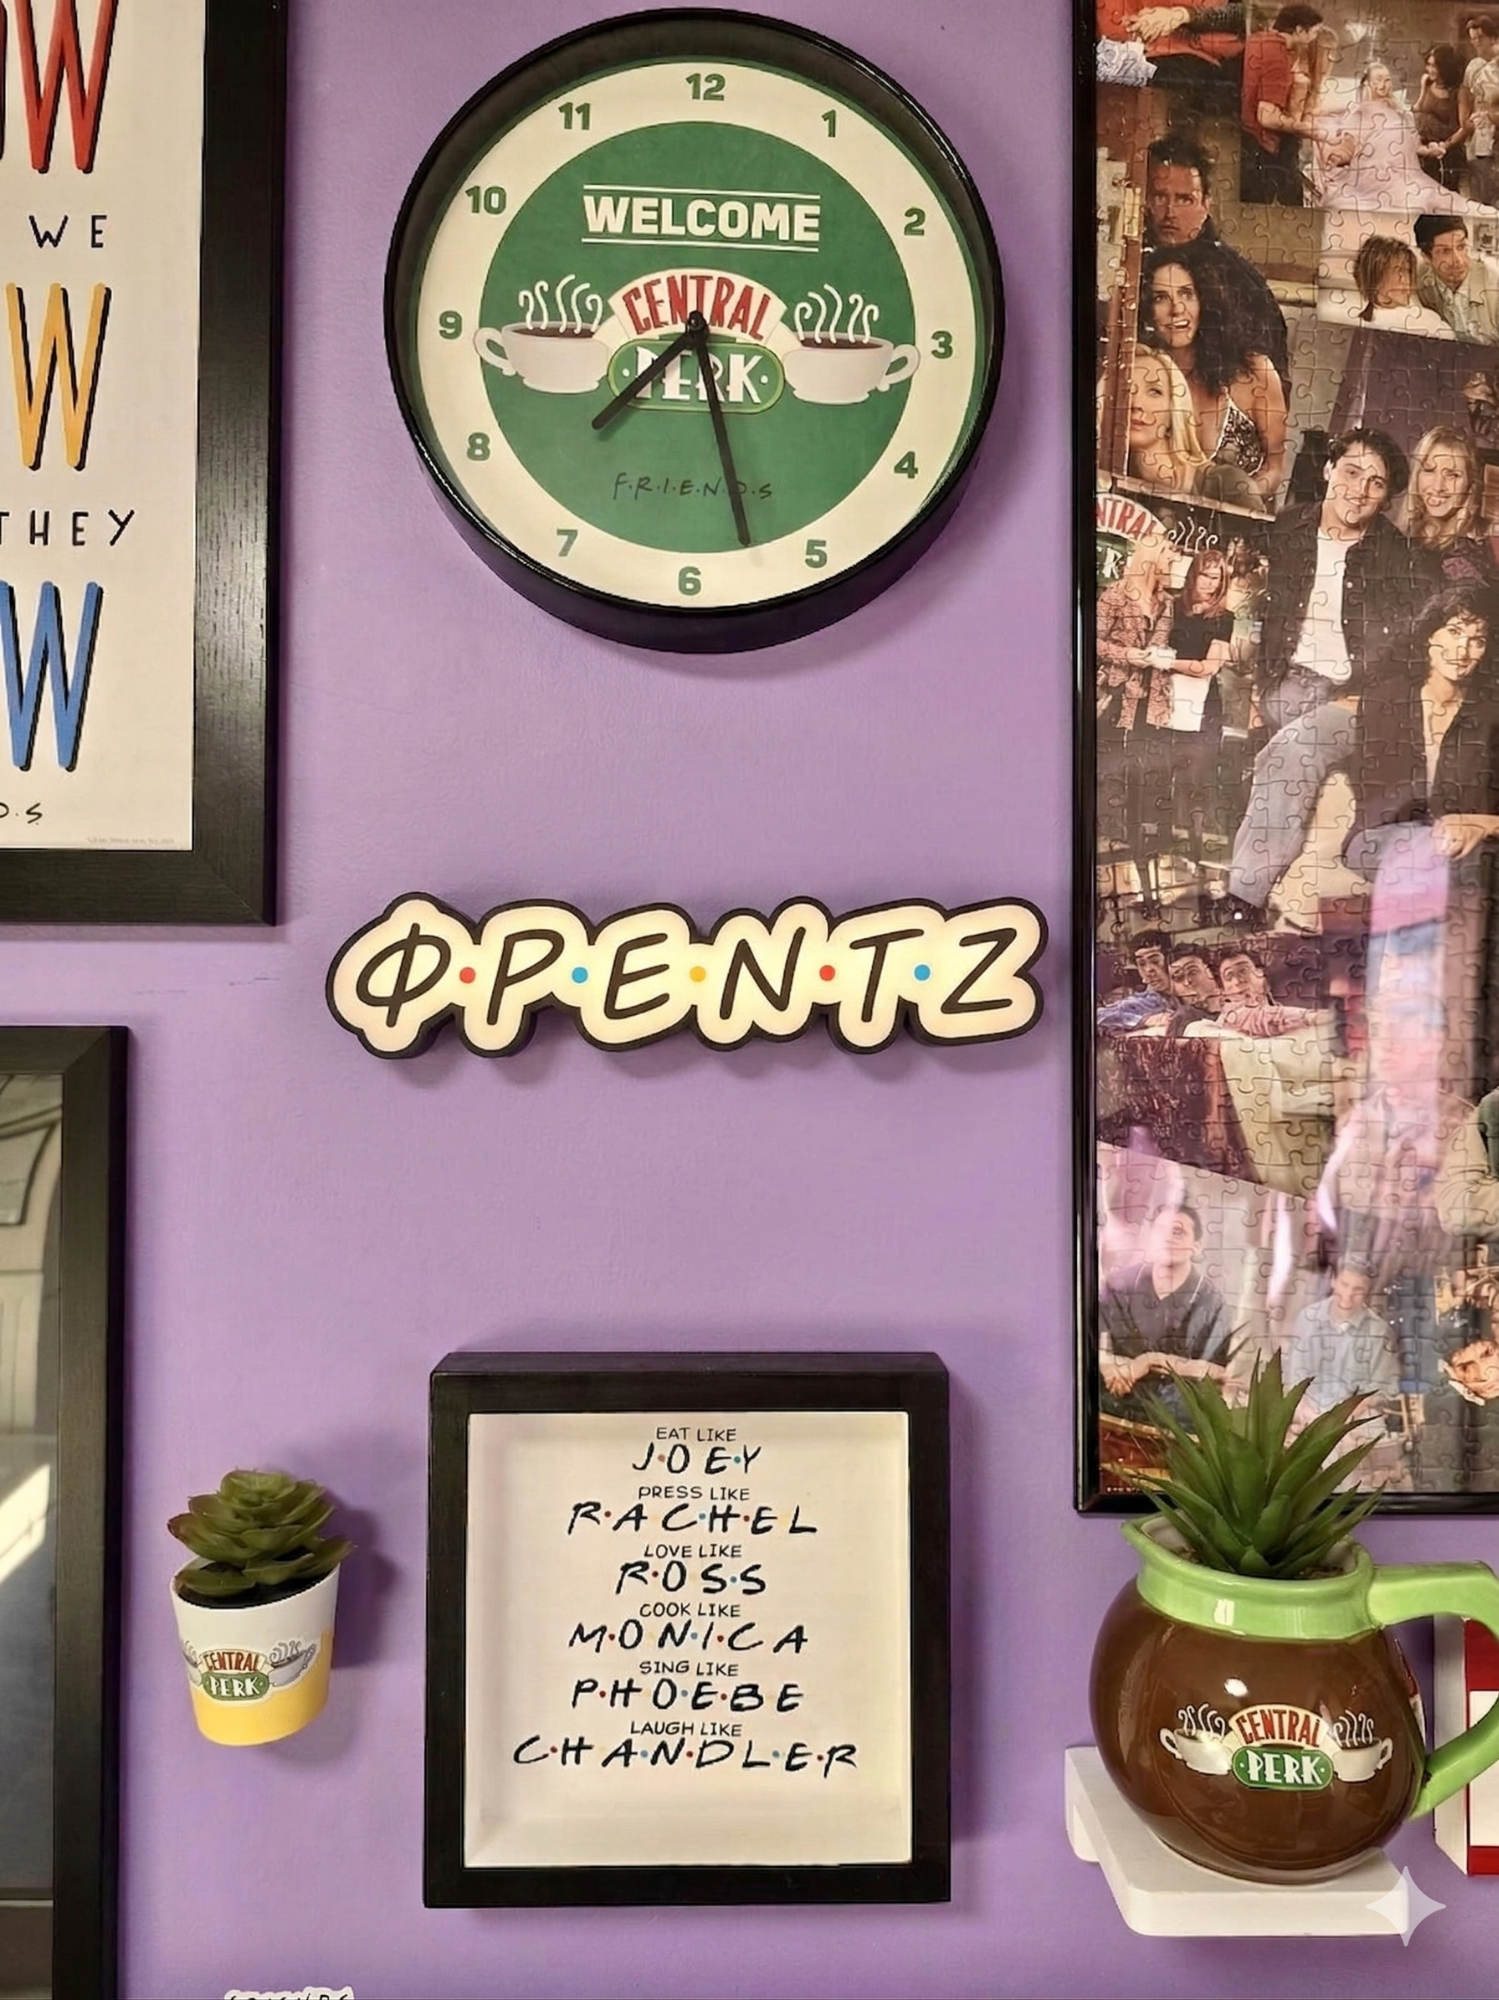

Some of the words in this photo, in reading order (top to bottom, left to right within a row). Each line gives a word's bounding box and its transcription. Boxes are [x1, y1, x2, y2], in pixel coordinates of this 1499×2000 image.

[686, 73, 725, 101] 12
[559, 102, 591, 131] 11
[821, 109, 837, 138] 1
[465, 186, 506, 214] 10
[29, 214, 107, 249] WE
[583, 195, 821, 241] WELCOME
[903, 208, 926, 236] 2
[622, 275, 771, 341] CENTRAL
[438, 311, 463, 339] 9
[931, 331, 953, 359] 3
[466, 432, 491, 461] 8
[893, 451, 919, 478] 4
[556, 529, 578, 557] 7
[804, 540, 828, 568] 5
[678, 567, 702, 596] 6
[656, 1427, 690, 1441] EAT
[696, 1428, 737, 1442] LIKE
[638, 1486, 702, 1500] PRESS
[710, 1487, 750, 1501] LIKE
[644, 1544, 692, 1558] LOVE
[699, 1544, 742, 1558] LIKE
[639, 1602, 691, 1618] COOK
[697, 1603, 740, 1617] LIKE
[203, 1652, 260, 1671] CENTRAL
[639, 1661, 690, 1675] SING
[696, 1663, 739, 1677] LIKE
[209, 1676, 260, 1697] PERK
[630, 1721, 694, 1736] LAUGH
[700, 1722, 742, 1737] LIKE
[1236, 1709, 1320, 1747] CENTRAL
[1246, 1750, 1322, 1785] PERK
